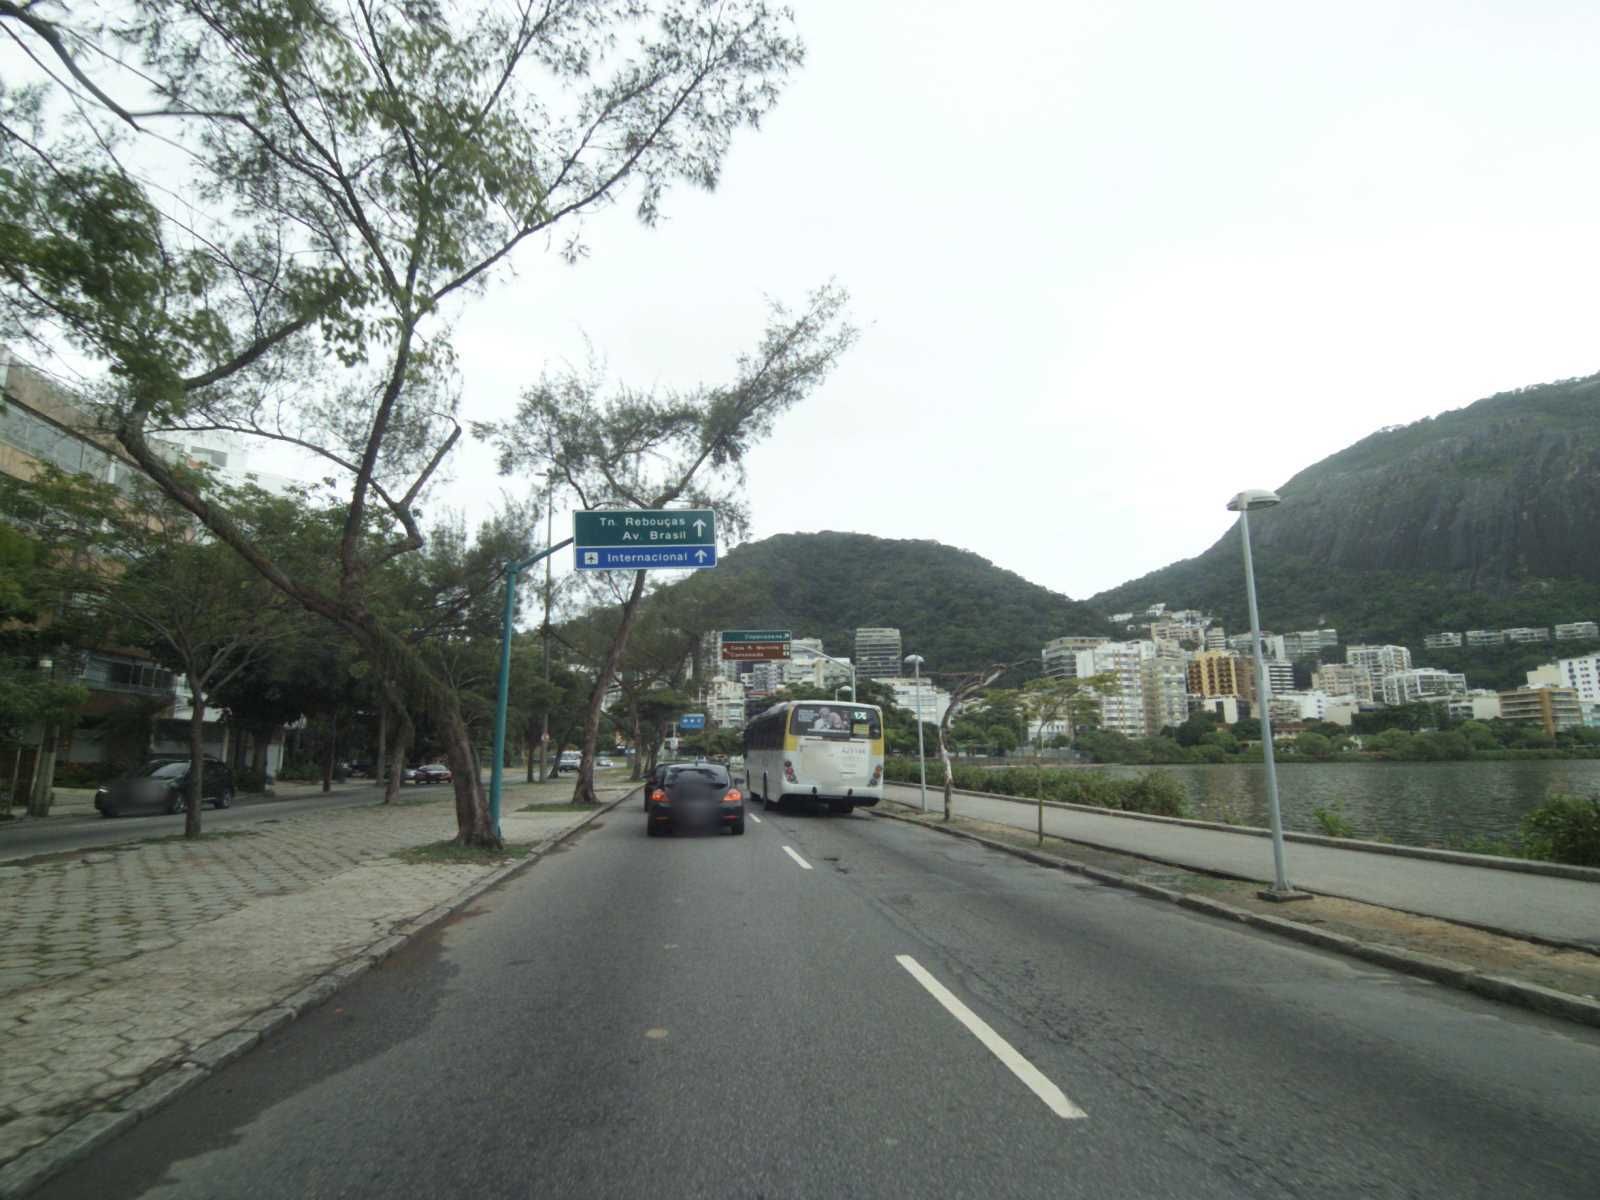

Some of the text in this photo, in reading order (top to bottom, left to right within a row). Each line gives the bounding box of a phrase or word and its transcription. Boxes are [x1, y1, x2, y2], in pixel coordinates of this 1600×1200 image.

[625, 517, 686, 528] Rebouças
[650, 531, 687, 541] Brasil
[607, 553, 688, 563] Internacional
